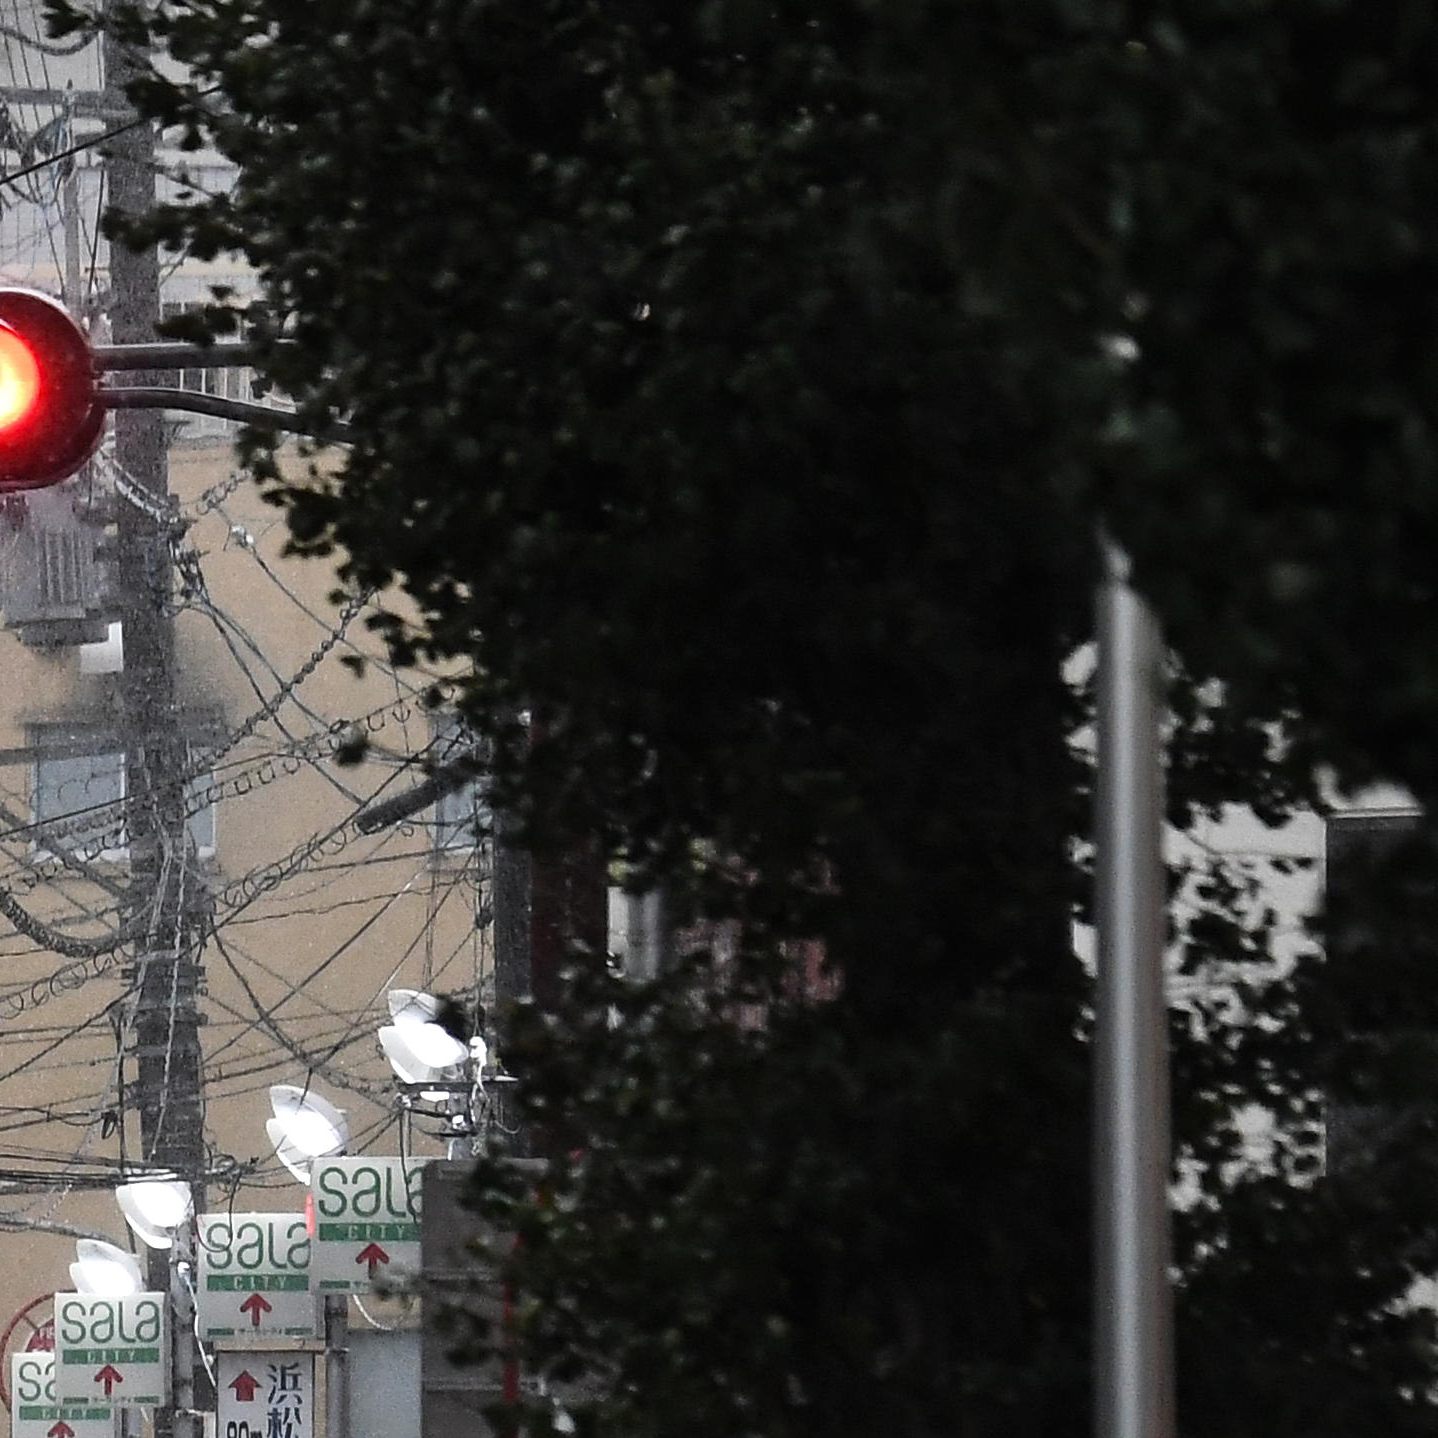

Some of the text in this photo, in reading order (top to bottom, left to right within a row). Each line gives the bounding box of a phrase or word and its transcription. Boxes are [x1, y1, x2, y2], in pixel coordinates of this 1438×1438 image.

[348, 1225, 405, 1239] CITY
[207, 1222, 311, 1269] sala
[234, 1276, 287, 1288] CITY
[62, 1301, 160, 1344] sala
[87, 1350, 135, 1363] CITY
